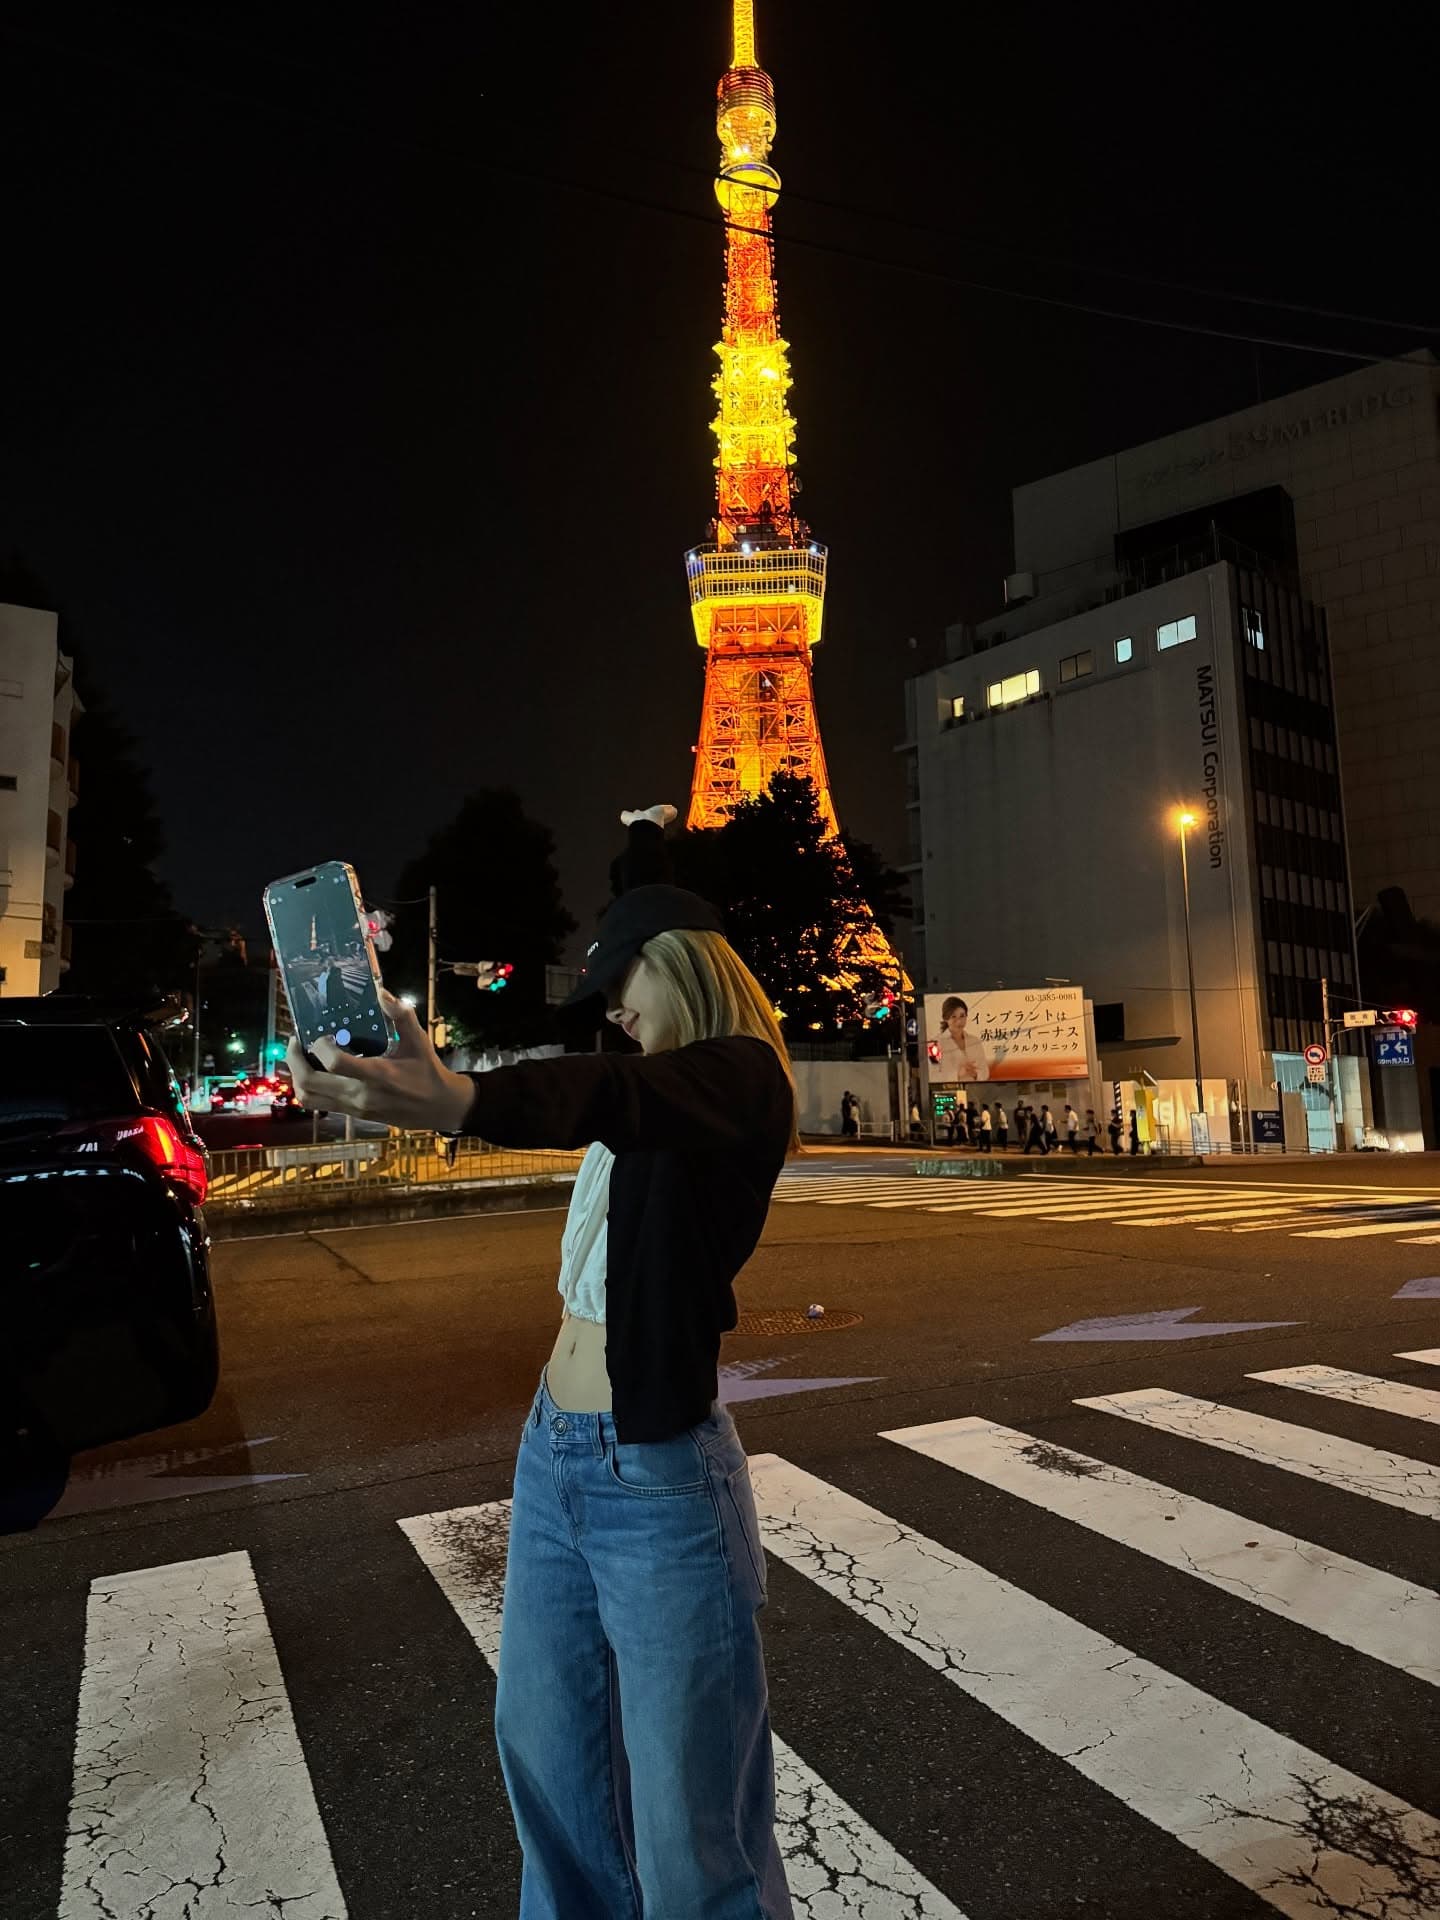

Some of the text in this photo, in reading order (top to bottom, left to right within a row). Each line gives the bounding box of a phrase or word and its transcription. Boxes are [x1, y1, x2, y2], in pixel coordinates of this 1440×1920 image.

[1197, 665, 1224, 869] MATSUI Corporation
[971, 1009, 1066, 1025] インプラントは
[980, 1026, 1079, 1042] 赤坂ヴィーナス
[992, 1042, 1079, 1055] デンタルクリニック
[1380, 1043, 1390, 1056] P
